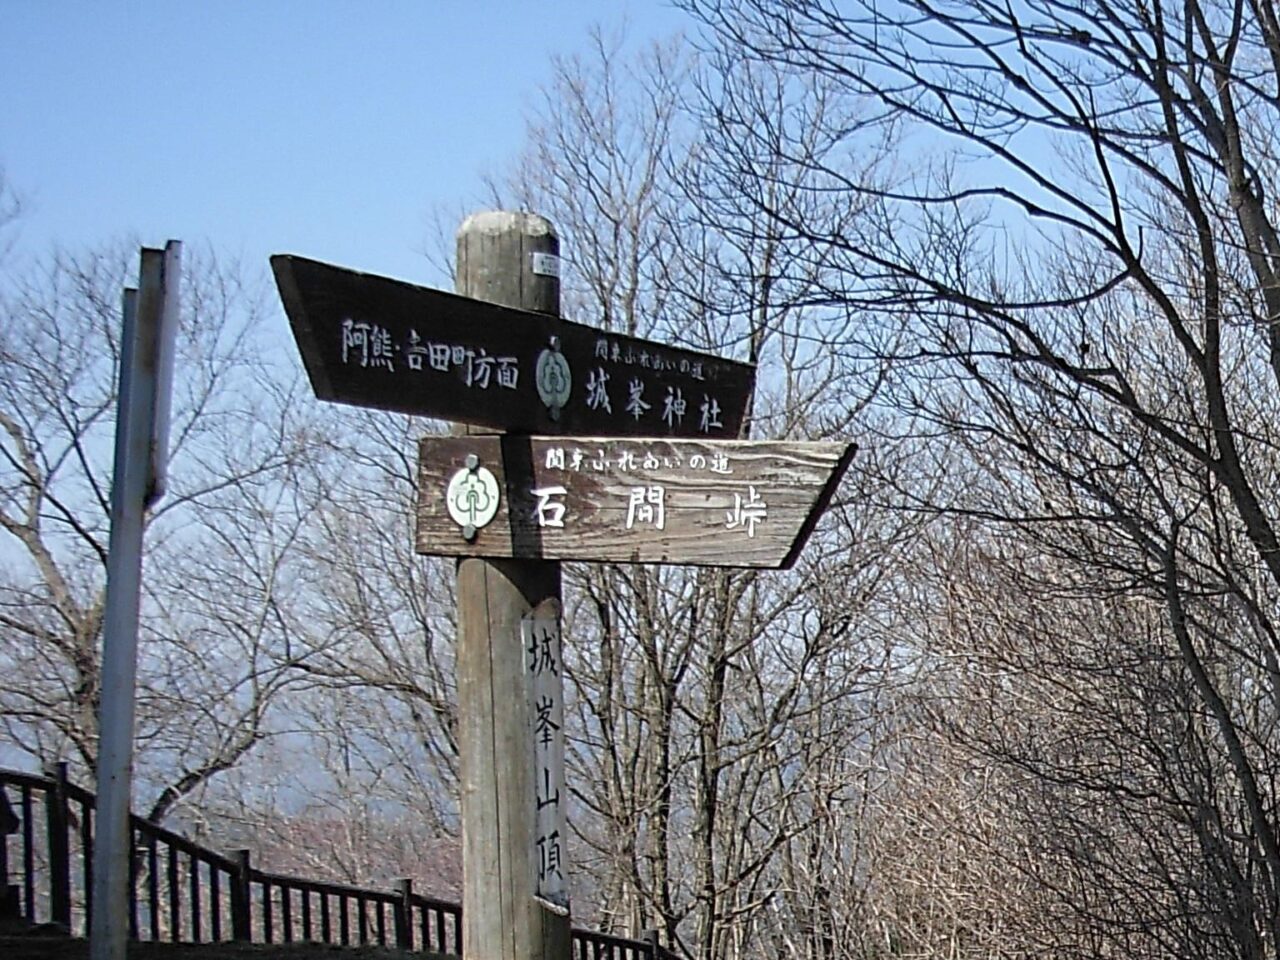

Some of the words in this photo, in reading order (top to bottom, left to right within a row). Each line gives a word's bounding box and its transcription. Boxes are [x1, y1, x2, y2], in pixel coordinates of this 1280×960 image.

[586, 366, 723, 433] 城峯神社
[530, 486, 768, 538] 石間峠
[529, 627, 563, 882] 城峯山頂
